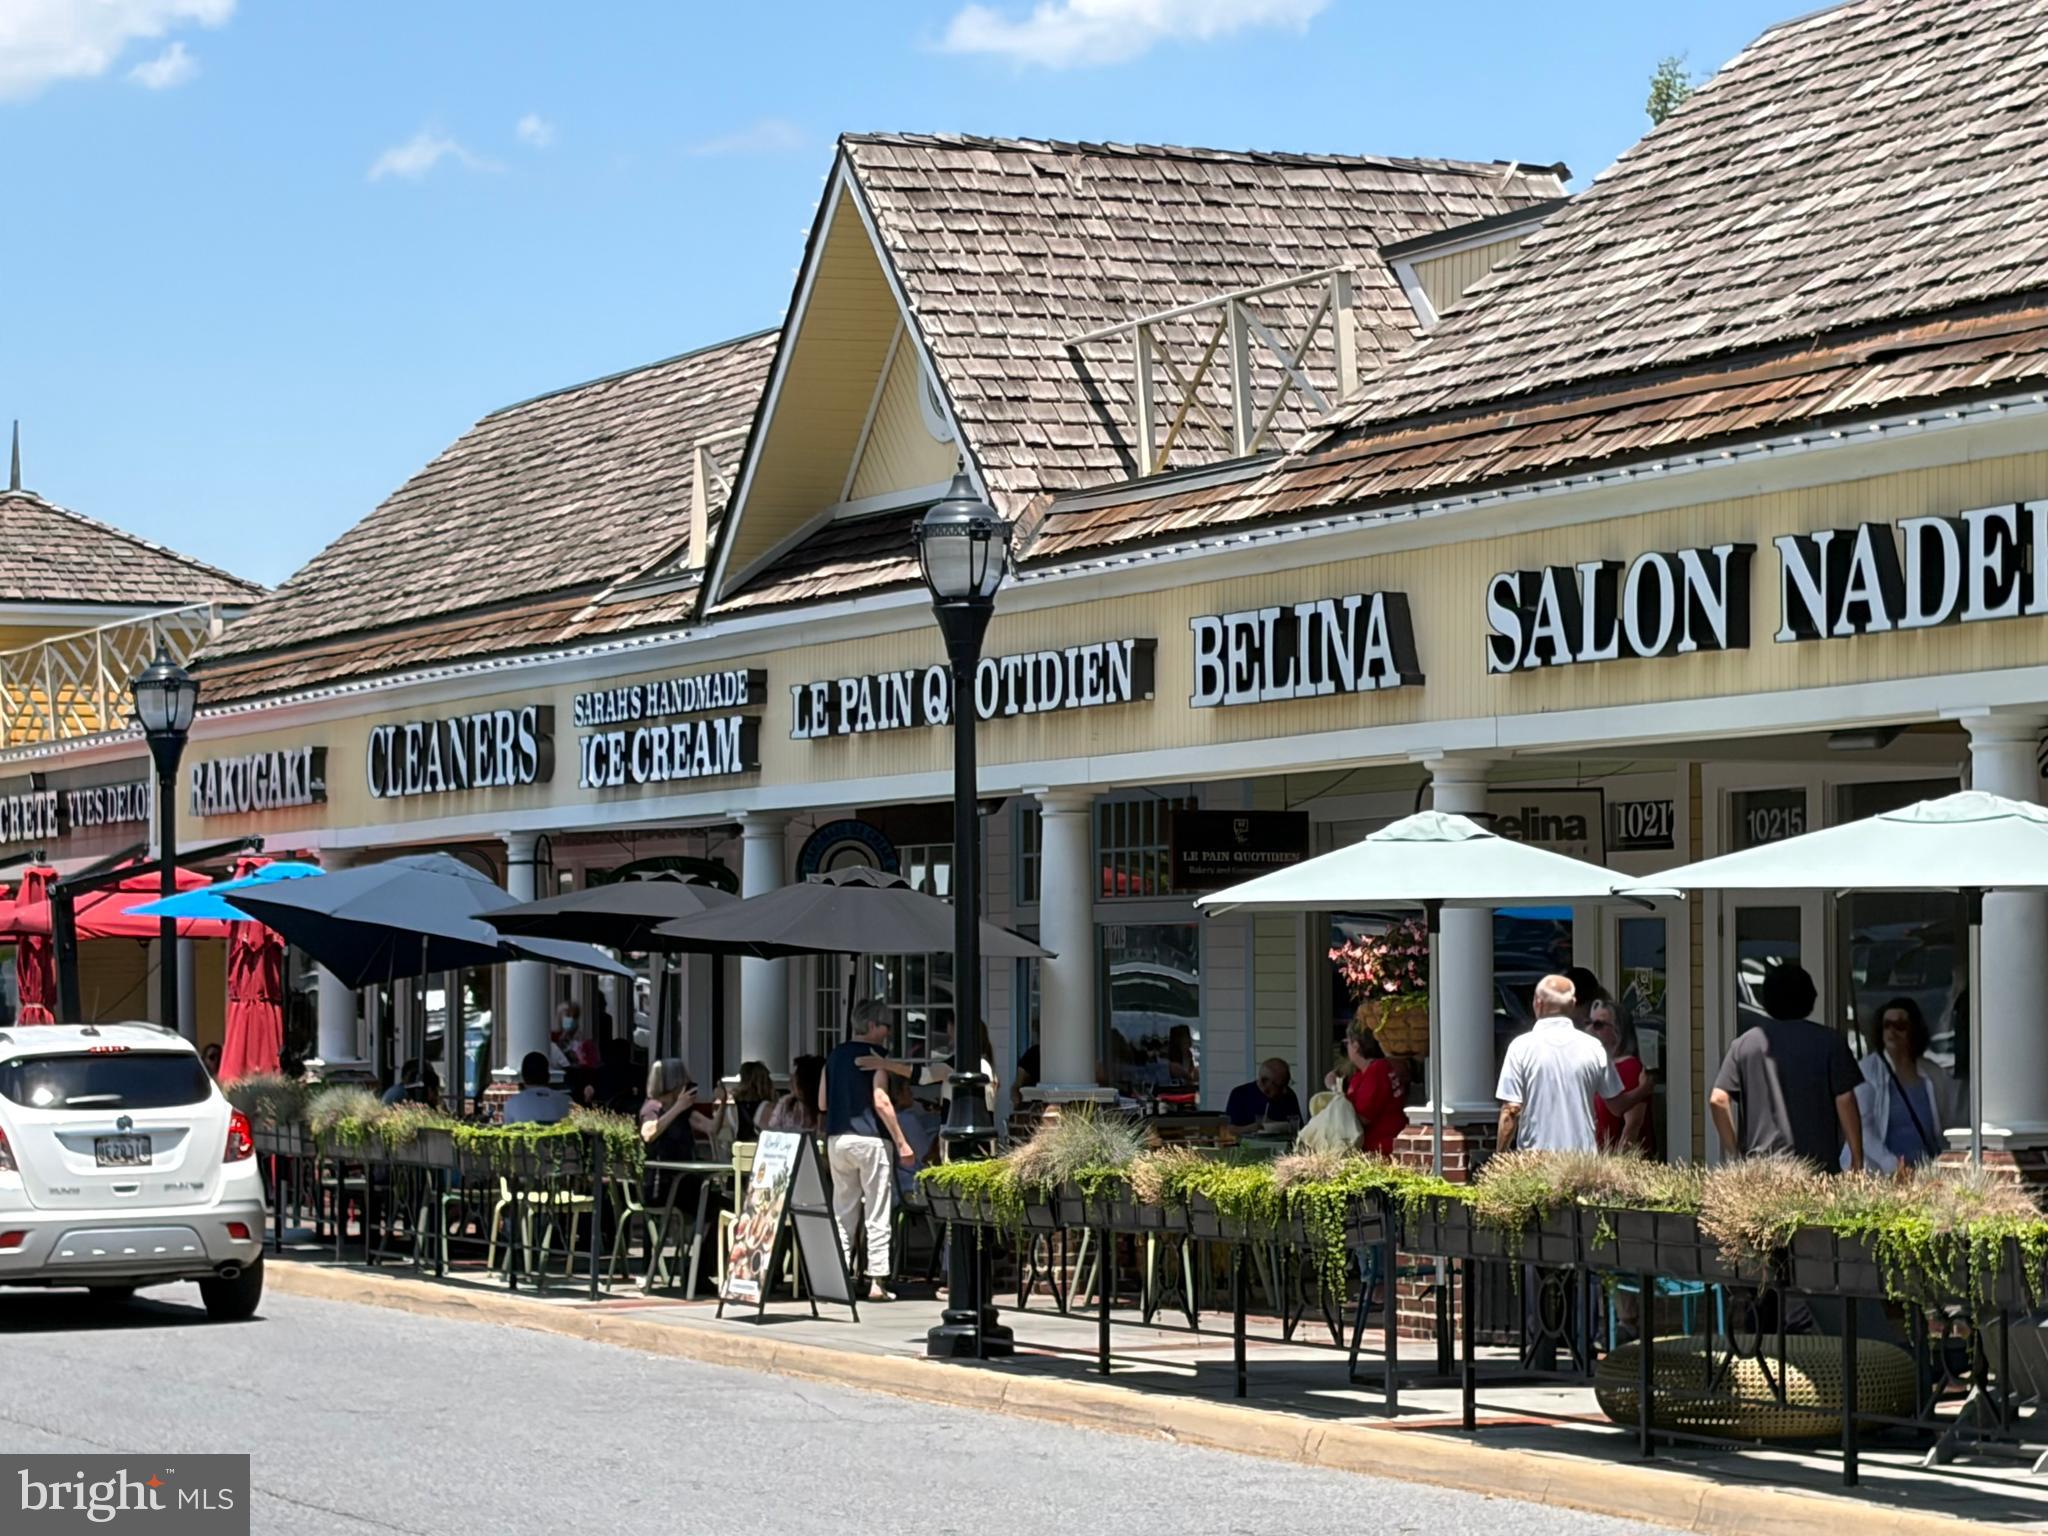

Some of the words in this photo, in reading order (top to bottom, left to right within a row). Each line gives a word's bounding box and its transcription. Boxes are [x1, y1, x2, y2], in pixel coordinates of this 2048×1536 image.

[1486, 543, 1735, 675] SALON
[1189, 591, 1402, 708] BELINA
[645, 669, 749, 717] HANDMADE
[789, 681, 831, 740] LE
[837, 669, 914, 735] PAIN
[922, 638, 1135, 726] QOTIDIEN
[189, 746, 313, 817] RAKUGAKI
[366, 704, 540, 799] CLEANERS
[578, 730, 626, 789] ICE
[631, 715, 744, 784] CREAM
[66, 785, 104, 828] YVES
[1746, 806, 1802, 841] 10215
[1182, 850, 1199, 862] LE
[1202, 850, 1230, 862] PAIN
[1233, 850, 1300, 862] QUOTIDIEN
